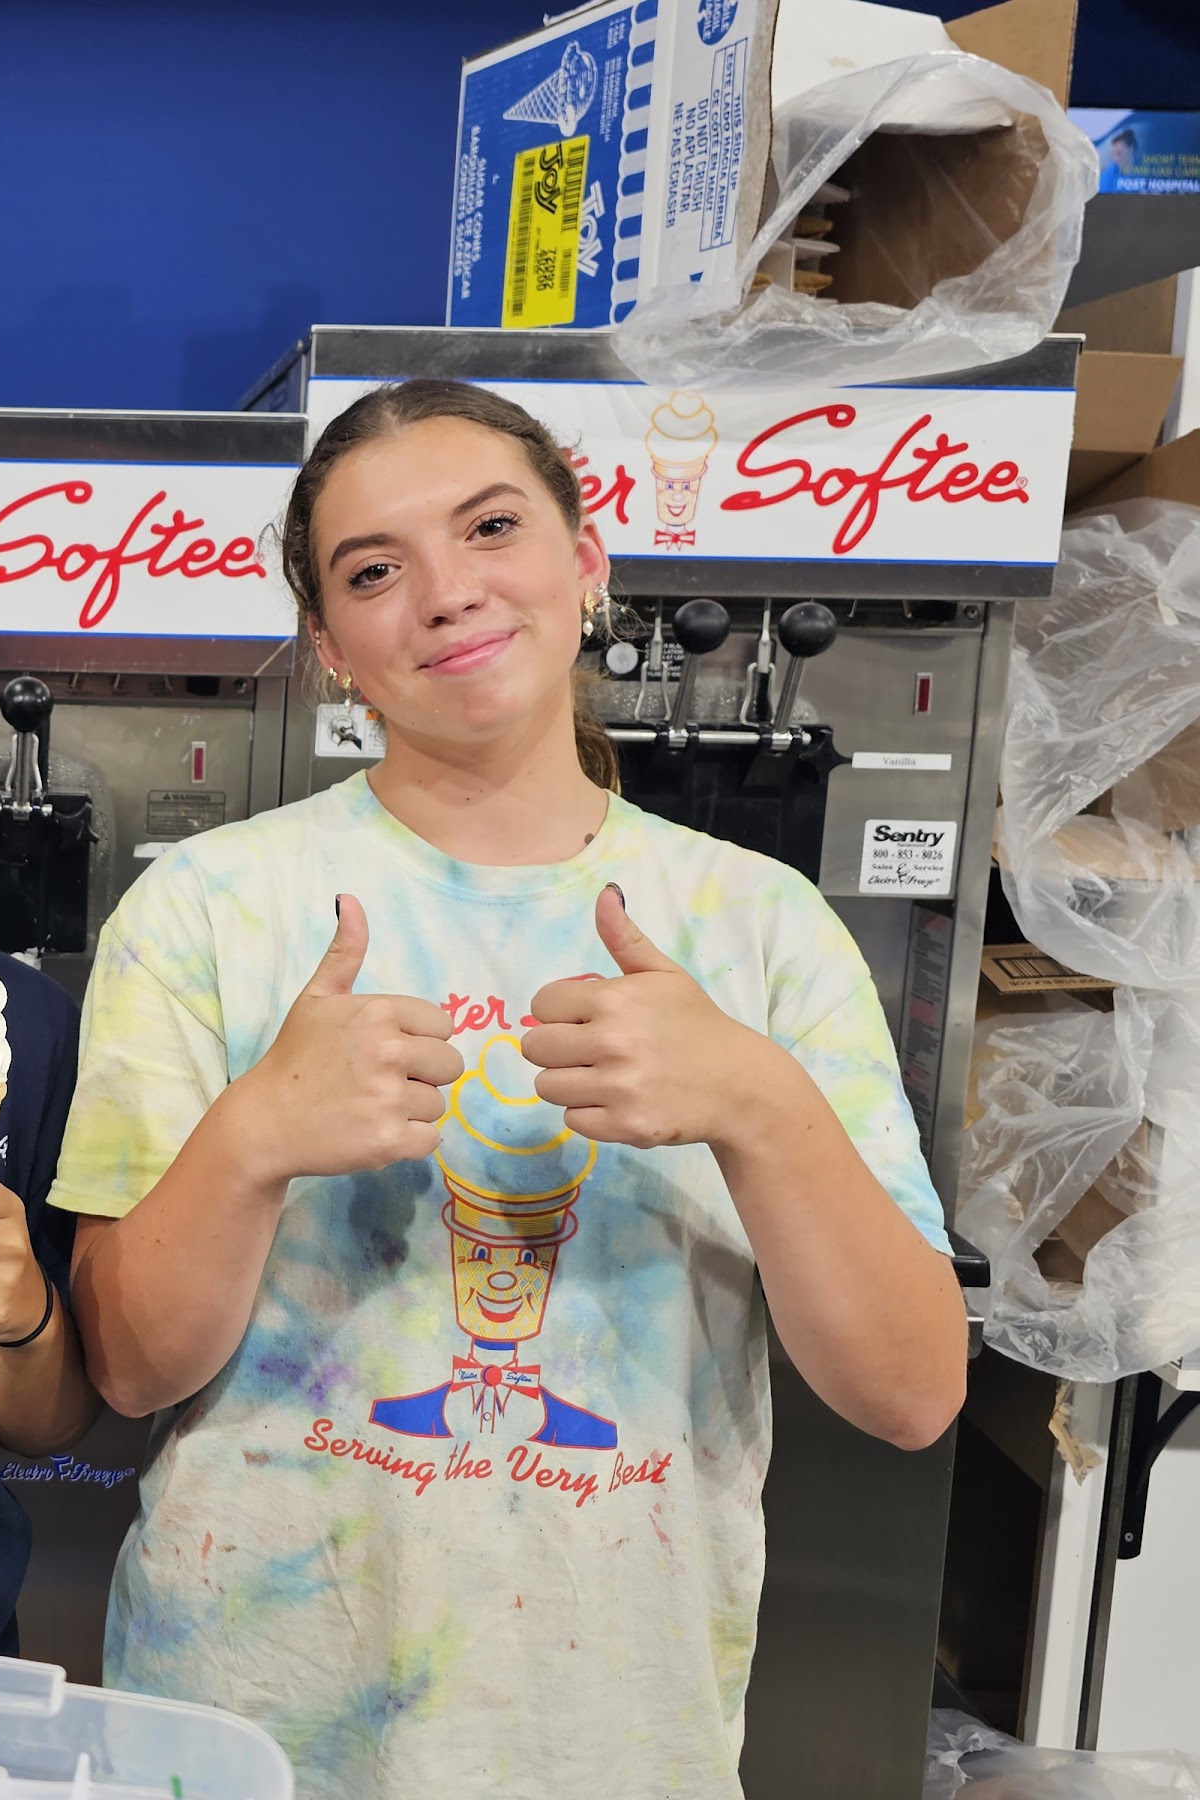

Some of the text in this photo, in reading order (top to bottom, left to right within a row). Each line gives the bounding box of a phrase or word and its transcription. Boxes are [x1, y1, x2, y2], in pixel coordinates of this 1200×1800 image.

[672, 102, 684, 125] NE
[712, 89, 721, 106] CE
[670, 128, 682, 158] PAS
[679, 107, 696, 214] NO APLASTAR
[691, 99, 709, 213] DO NOT CRUSH
[713, 53, 734, 241] ESTE LADO HACIA ARRIBA
[729, 94, 742, 190] THIS SIDE UP
[709, 153, 718, 172] EN
[457, 153, 469, 221] CORNETS
[705, 176, 716, 213] HAUT
[464, 217, 474, 237] DE
[471, 157, 487, 263] SUGAR CONES
[720, 404, 1029, 555] Softee
[883, 757, 916, 766] Vanilla
[873, 825, 945, 847] Sentry
[873, 849, 889, 859] 800
[897, 849, 913, 859] 853
[921, 850, 943, 860] 8026
[440, 993, 512, 1035] ter
[1, 1462, 54, 1481] Electro
[70, 1463, 126, 1489] Freeze
[304, 1418, 673, 1508] Serving the Very Best
